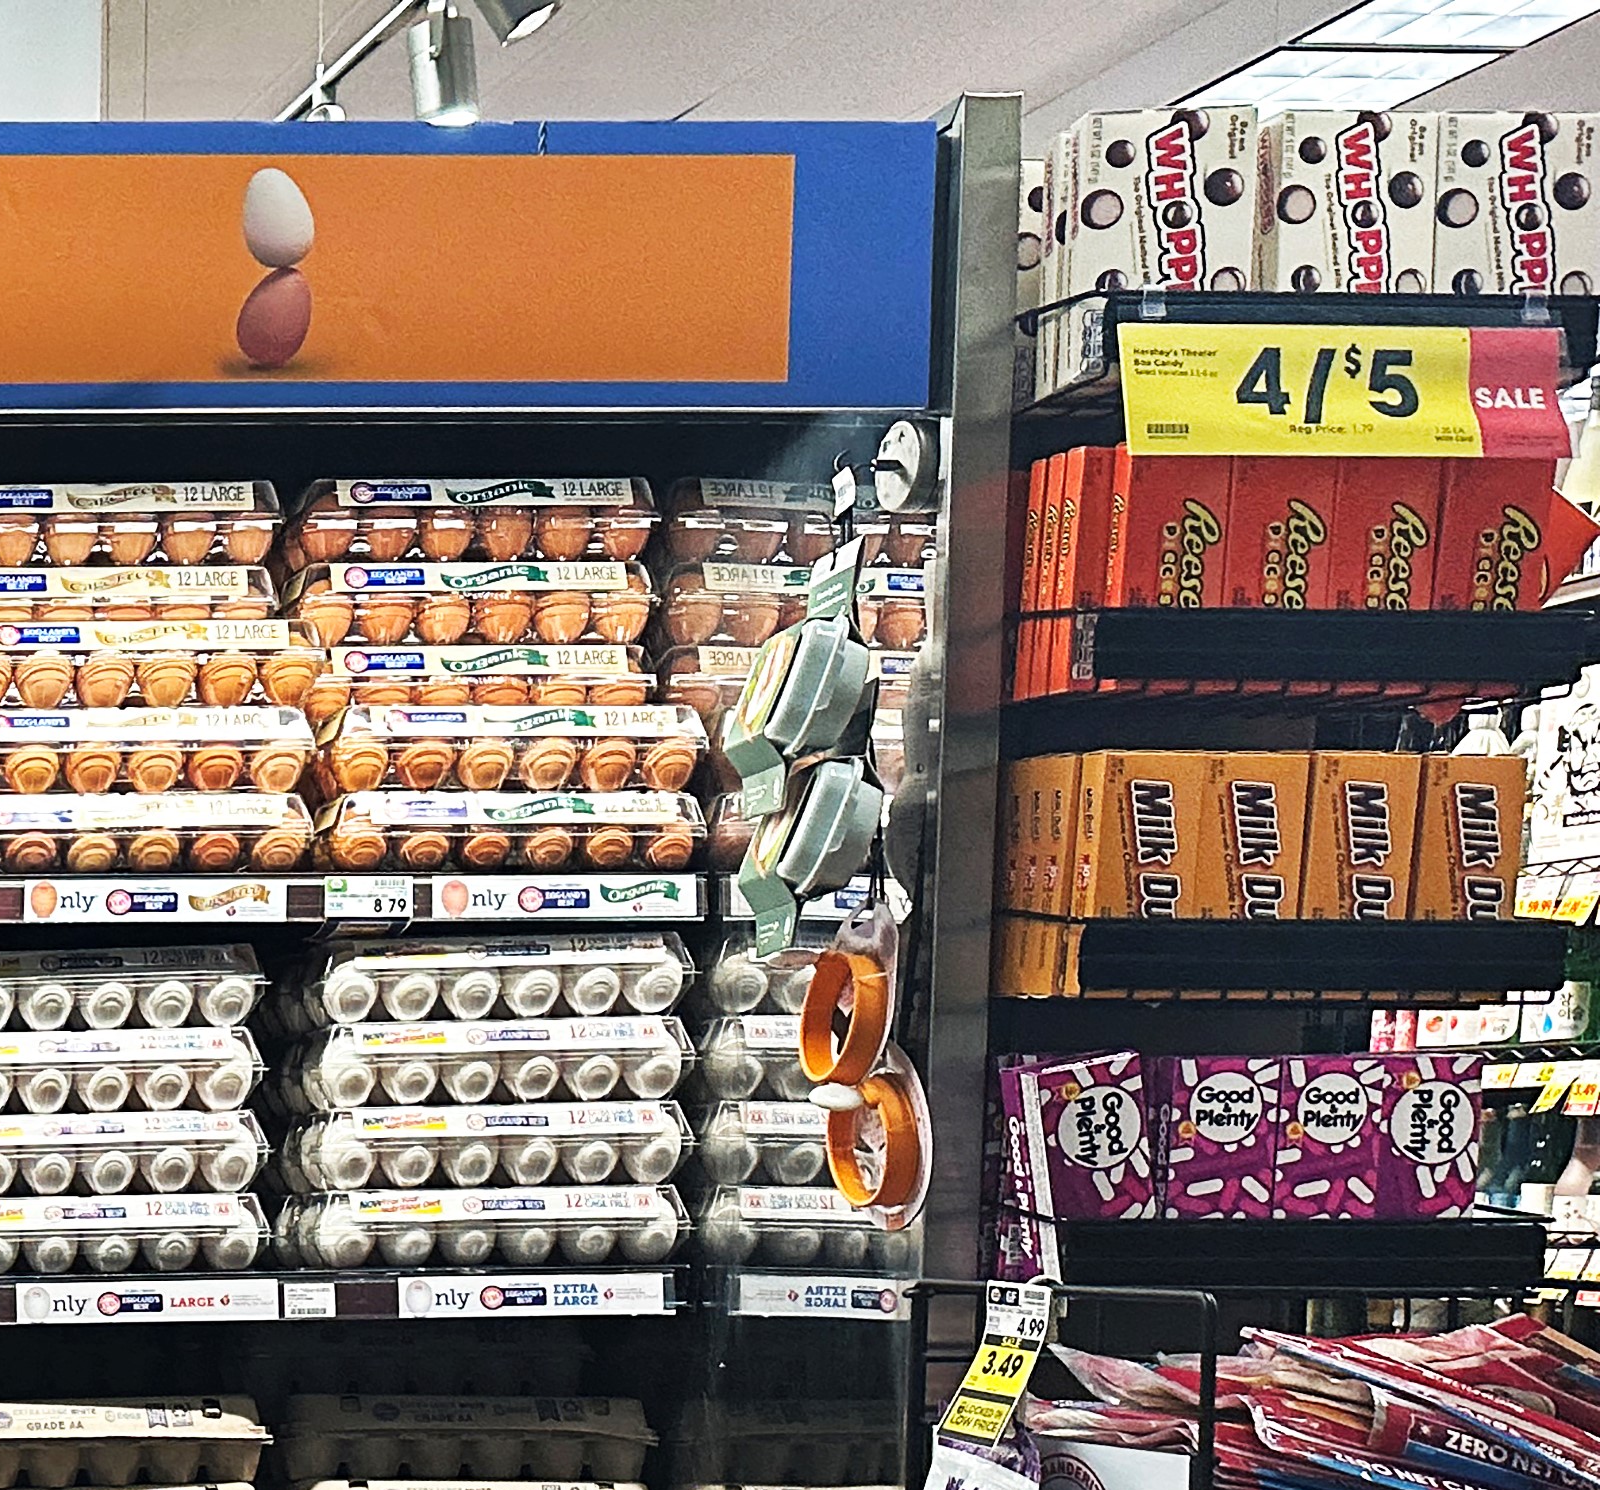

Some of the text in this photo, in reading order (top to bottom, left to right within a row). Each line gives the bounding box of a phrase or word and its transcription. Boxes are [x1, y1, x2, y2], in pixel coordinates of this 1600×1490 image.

[1150, 126, 1204, 291] WHOPP
[1340, 124, 1389, 293] WHOPP
[1476, 386, 1545, 409] SALE
[1289, 424, 1312, 435] Reg
[183, 486, 198, 502] 12
[201, 486, 246, 502] LARGE
[562, 481, 625, 497] 12 LARGE
[1132, 780, 1176, 866] Milk
[1232, 781, 1280, 867] Milk
[1346, 781, 1391, 867] Milk
[1456, 782, 1501, 868] Milk
[1198, 1086, 1254, 1105] Good
[1305, 1086, 1359, 1105] Good
[1076, 1097, 1098, 1166] Plenty
[1101, 1091, 1129, 1155] Good
[1195, 1109, 1259, 1131] Plenty
[1304, 1109, 1364, 1131] Plenty
[1412, 1087, 1432, 1161] Plenty
[1438, 1091, 1459, 1154] Good
[553, 1284, 599, 1294] EXTRA
[553, 1295, 599, 1306] LARGE
[170, 1297, 216, 1308] LARGE
[982, 1351, 1024, 1379] 3.49
[949, 1416, 1000, 1433] LOW PRICE
